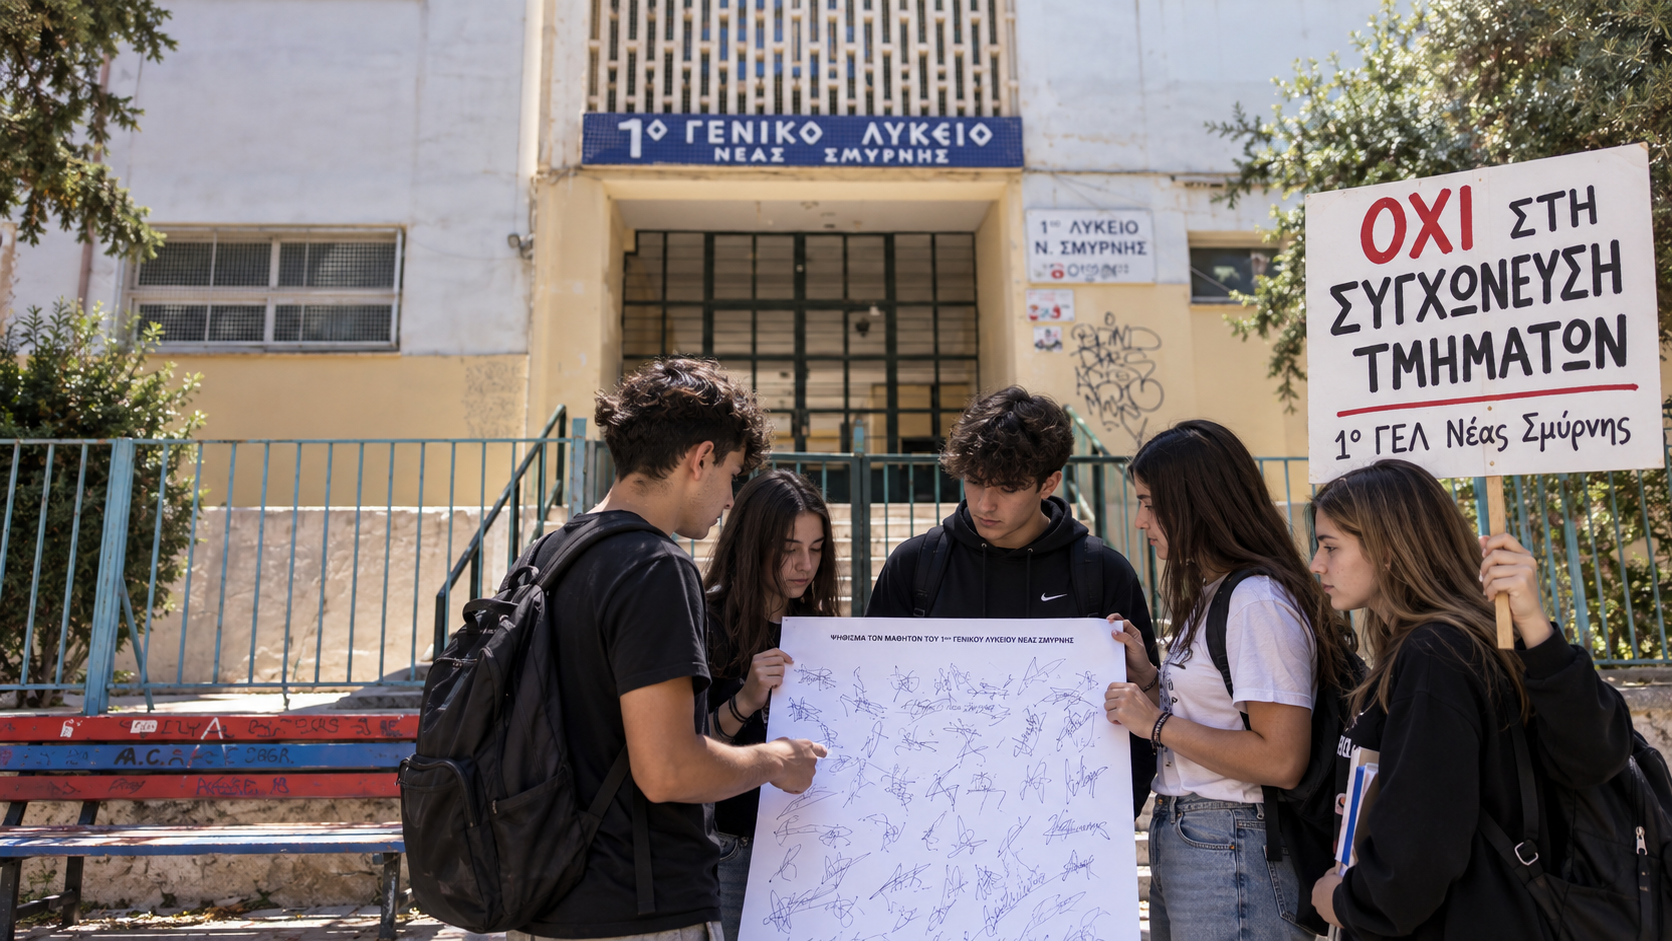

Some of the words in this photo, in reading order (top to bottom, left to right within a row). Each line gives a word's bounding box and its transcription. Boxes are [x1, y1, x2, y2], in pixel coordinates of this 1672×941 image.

[686, 120, 823, 146] ΓΕΝΙΚΟ
[862, 121, 993, 147] ΛΥΚΕΙΟ
[714, 147, 784, 162] ΝΕΑΣ
[824, 147, 949, 164] ΣΜΥΡΝΗΣ
[1069, 220, 1139, 235] ΛΥΚΕΙΟ
[1360, 185, 1473, 264] ΟΧΙ
[1509, 185, 1598, 239] ΣΤΗ
[1035, 241, 1053, 255] Ν.
[1060, 241, 1148, 255] ΣΜΥΡΝΗΣ
[1330, 239, 1622, 336] ΣΥΓΧΩΝΕΥΣΗ
[1353, 314, 1627, 393] ΤΜΗΜΑΤΩΝ
[1375, 422, 1430, 455] ΓΕΛ
[1447, 416, 1508, 452] Νέας
[1522, 410, 1631, 452] Σμύρνης
[867, 634, 883, 642] ΤΟΝ
[924, 635, 939, 643] ΤΟΥ
